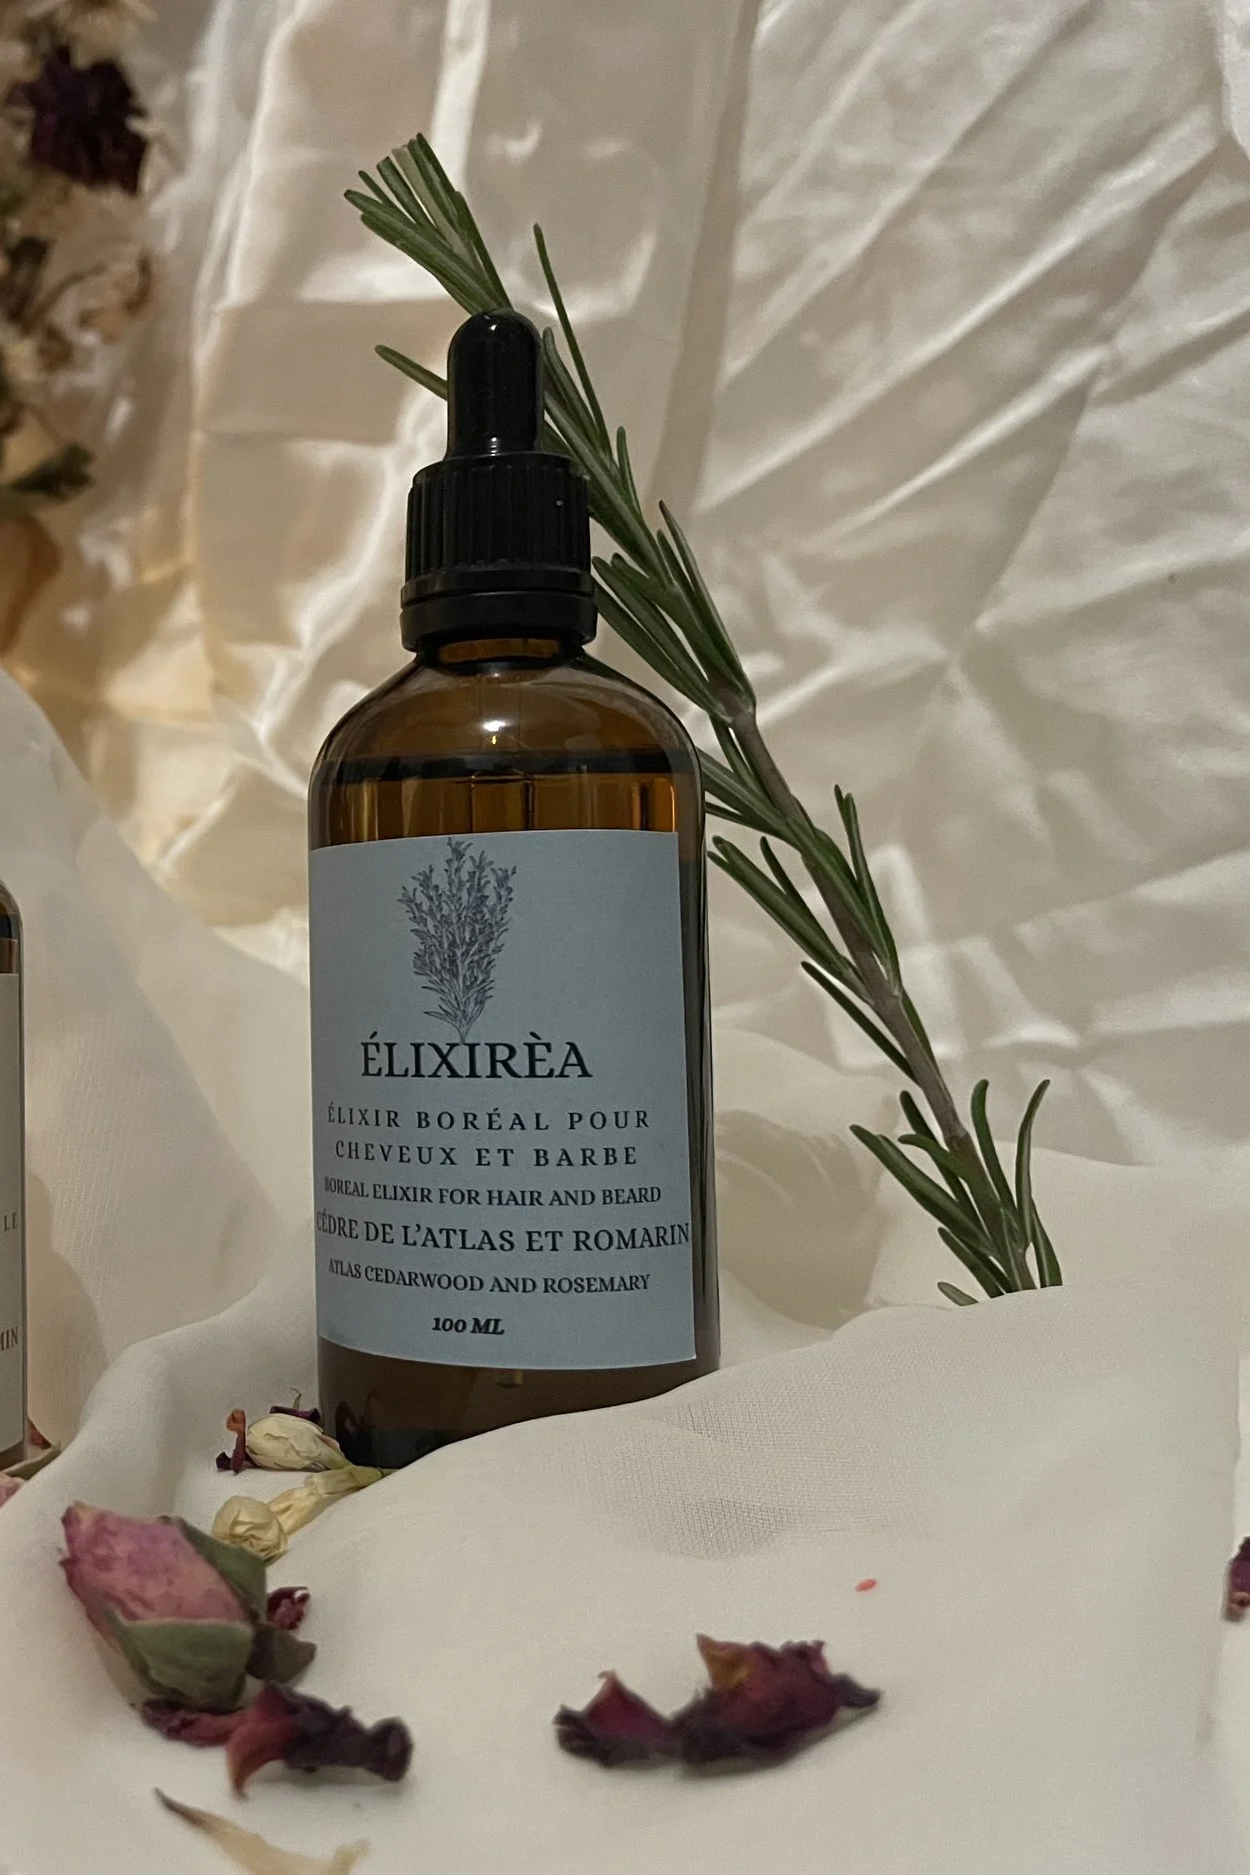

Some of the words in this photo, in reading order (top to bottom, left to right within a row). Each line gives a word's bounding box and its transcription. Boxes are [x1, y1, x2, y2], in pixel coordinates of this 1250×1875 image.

[360, 1031, 593, 1079] ÉLIXIRÈA
[327, 1102, 401, 1127] ÉLIXIR
[416, 1107, 550, 1131] BORÉAL
[568, 1109, 650, 1131] POUR
[335, 1140, 458, 1166] CHEVEUX
[475, 1147, 515, 1167] ET
[533, 1146, 638, 1167] BARBE
[324, 1176, 369, 1198] BOREAL
[372, 1183, 434, 1203] ELIXIR
[438, 1188, 481, 1205] FOR
[486, 1189, 544, 1206] HAIR
[548, 1189, 596, 1206] AND
[602, 1186, 662, 1205] BEARD
[364, 1221, 395, 1244] DE
[525, 1230, 564, 1253] ET
[573, 1221, 691, 1252] ROMARIN
[328, 1258, 361, 1279] ATLAS
[364, 1265, 485, 1292] CEDARWOOD
[489, 1276, 537, 1294] AND
[542, 1273, 651, 1294] ROSEMARY
[432, 1316, 467, 1333] 100
[470, 1317, 505, 1335] ML
